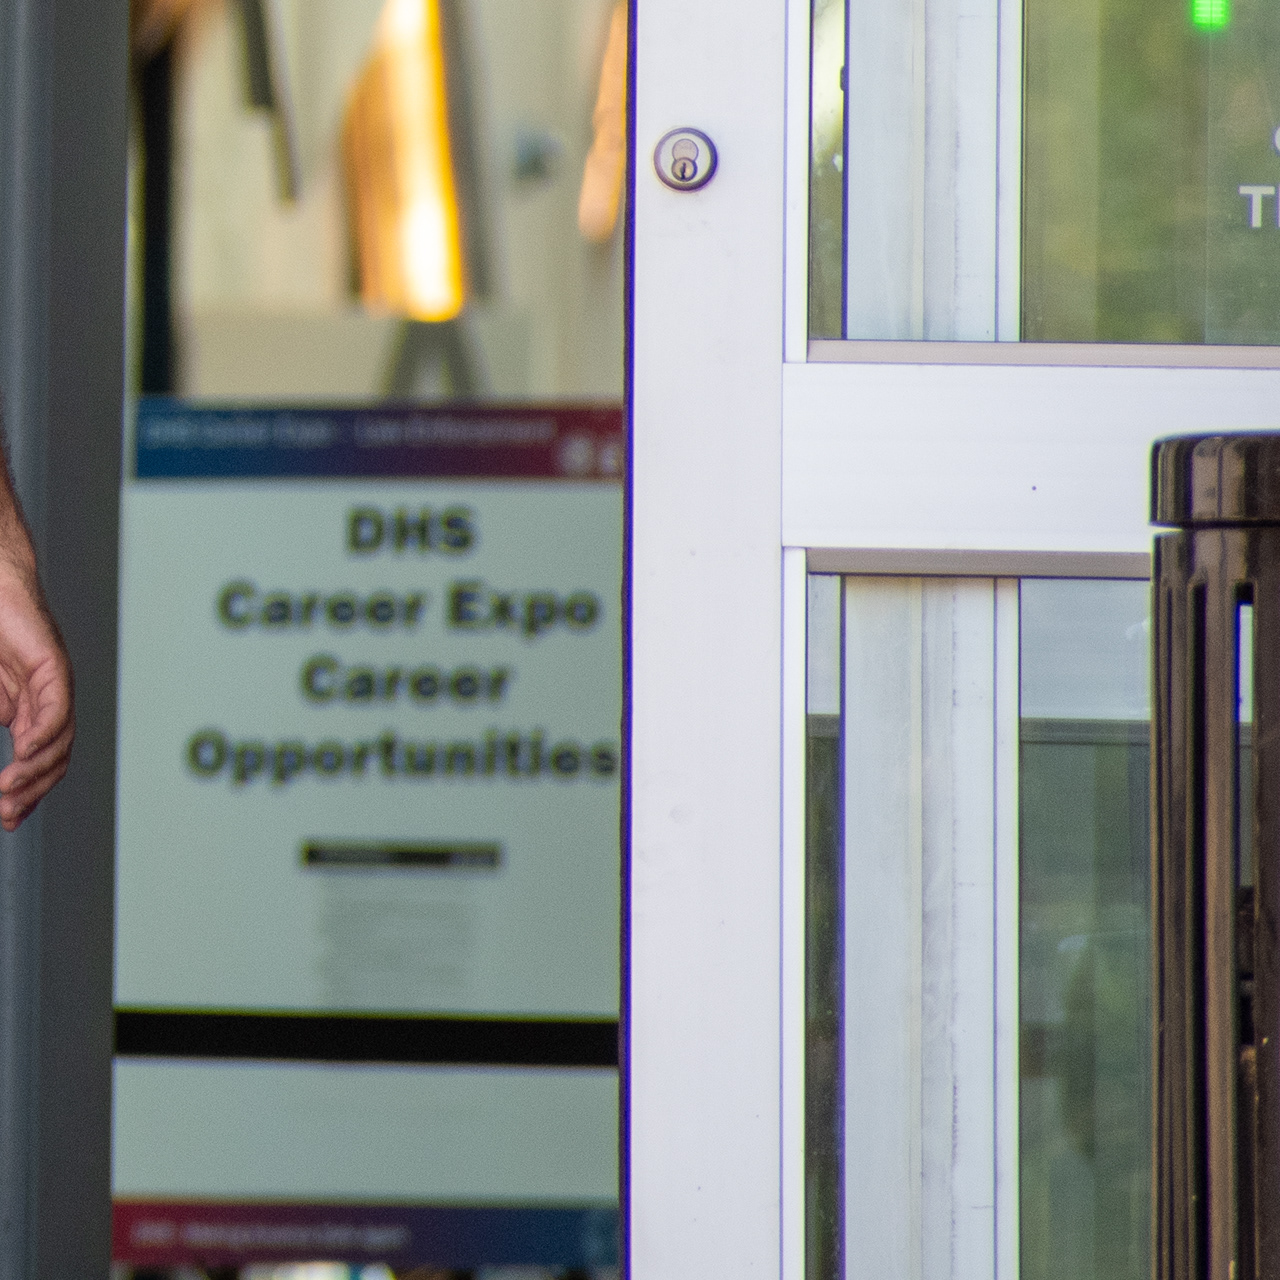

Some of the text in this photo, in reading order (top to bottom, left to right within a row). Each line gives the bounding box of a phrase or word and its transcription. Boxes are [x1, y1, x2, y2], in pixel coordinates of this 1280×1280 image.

[345, 507, 477, 554] DHS
[217, 582, 603, 640] Career Expo
[301, 655, 512, 704] Career
[187, 730, 617, 785] Opportunities
